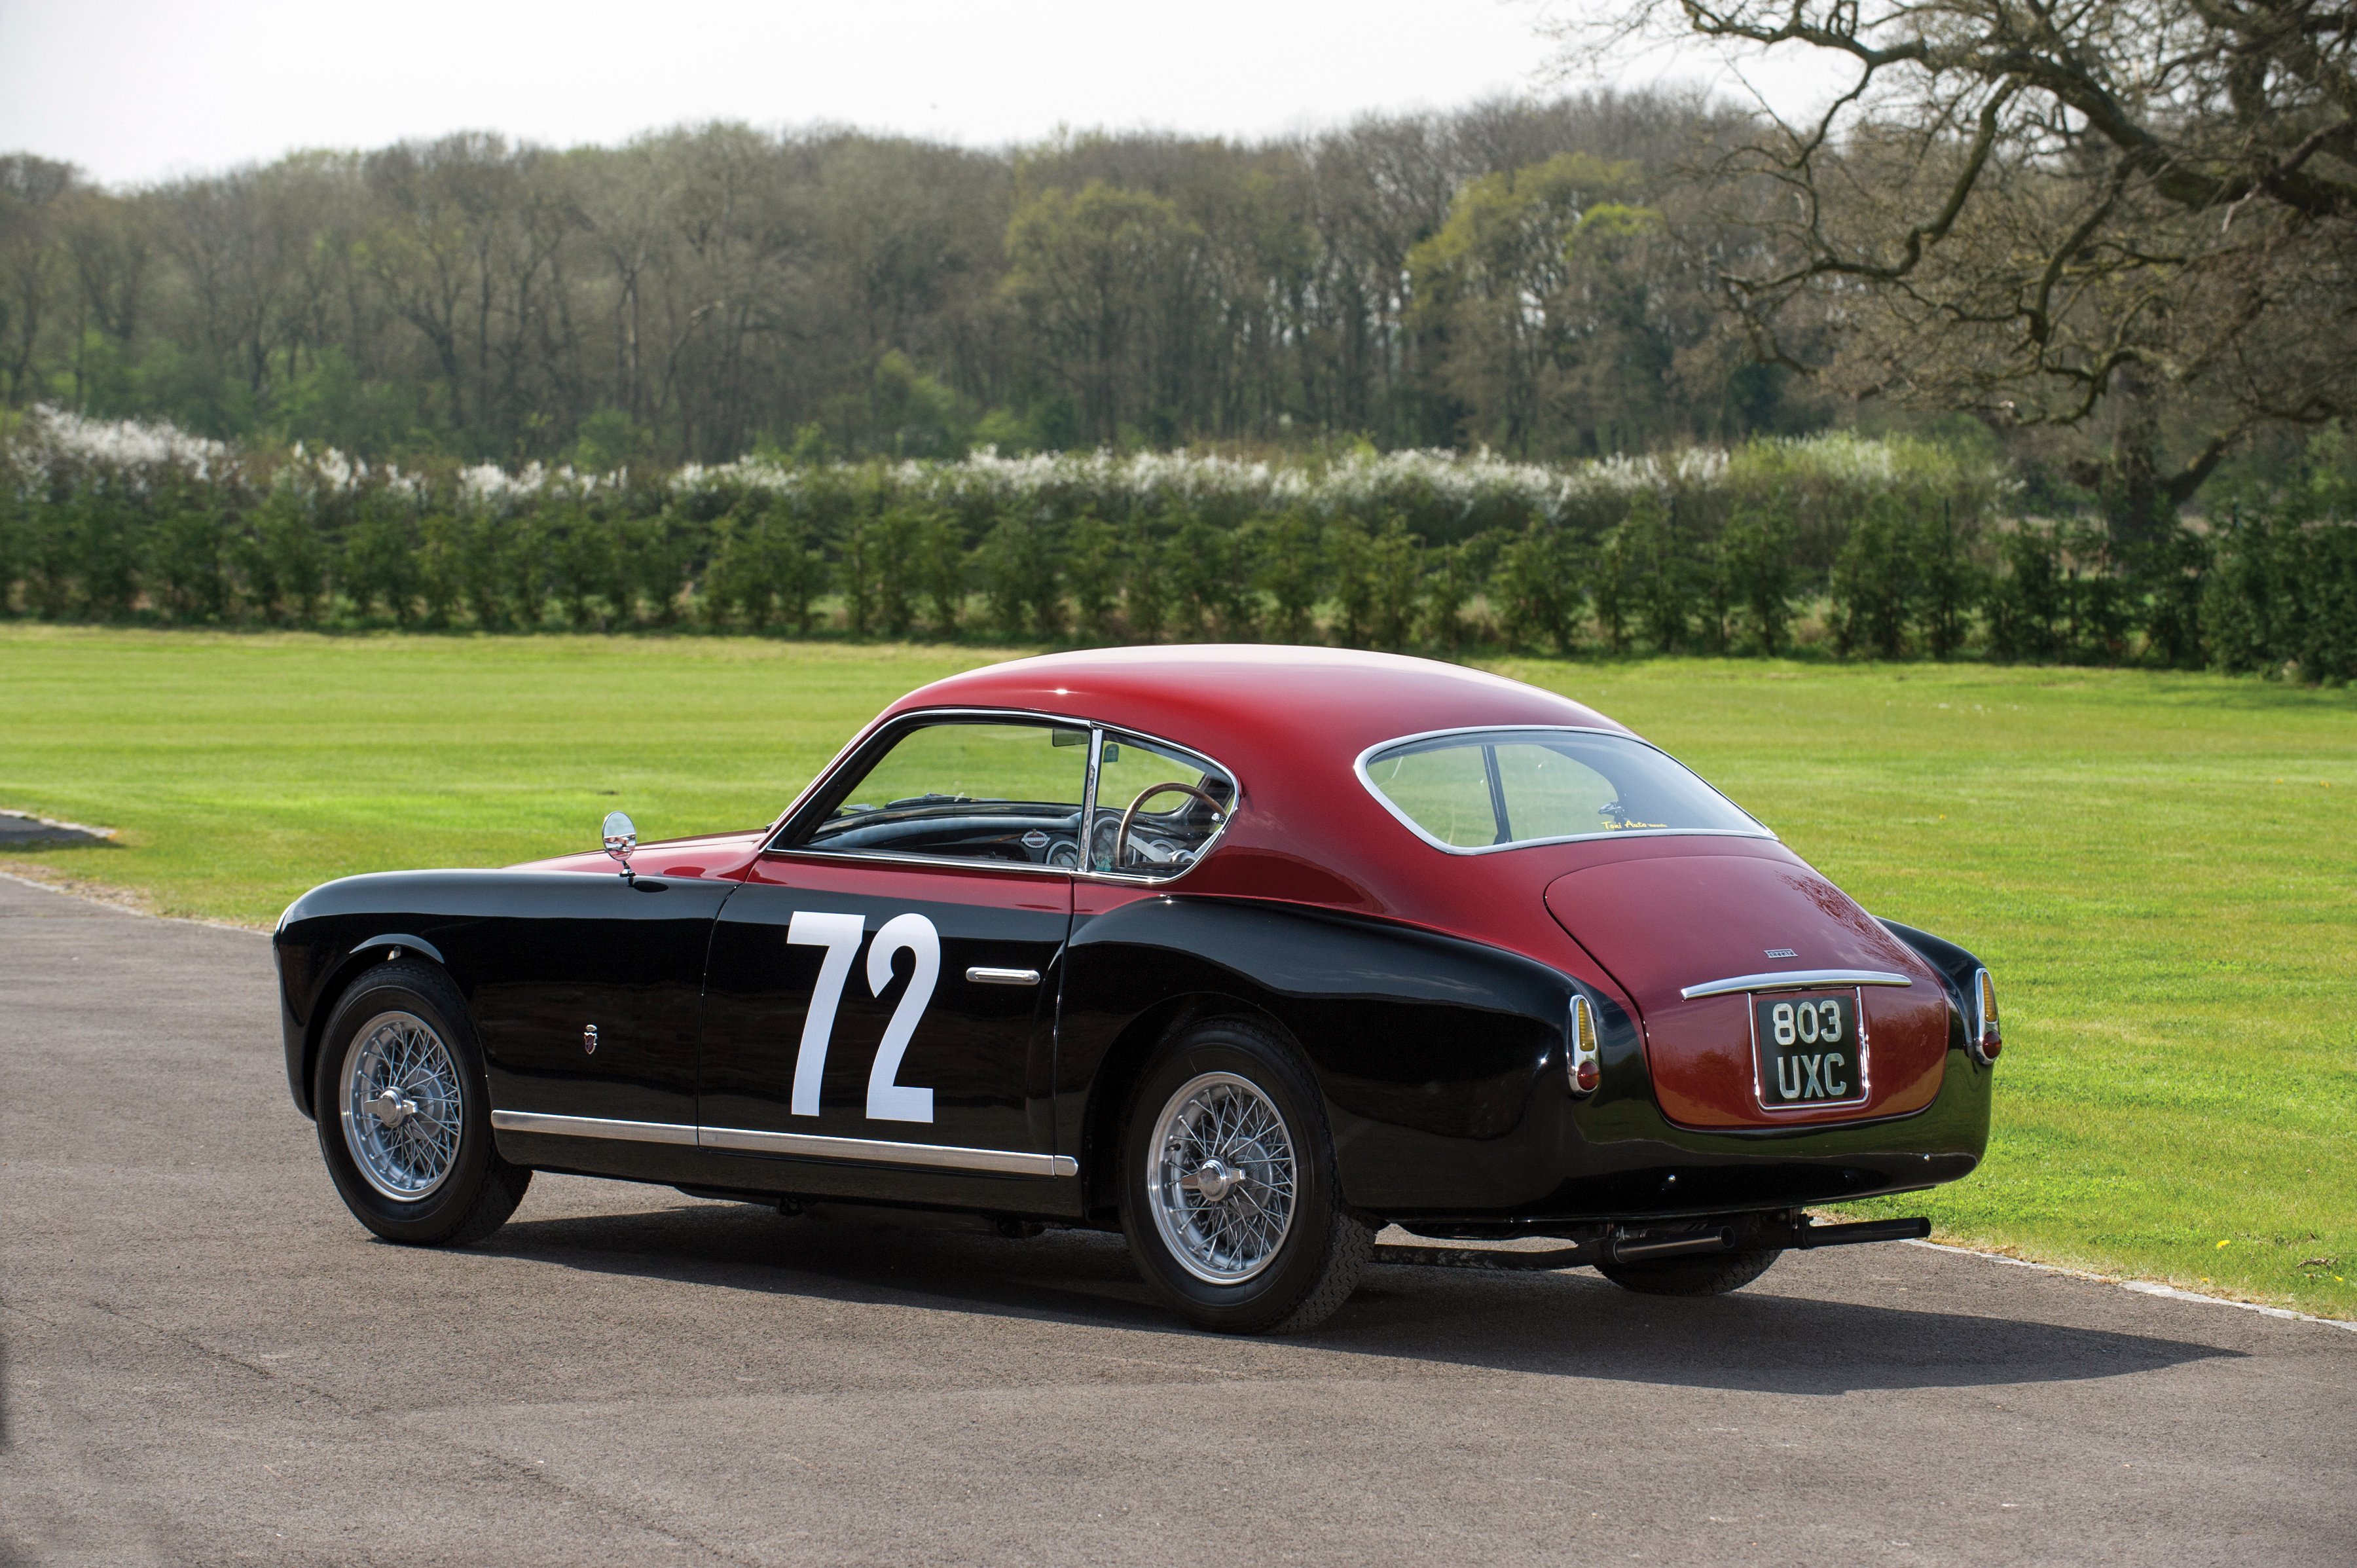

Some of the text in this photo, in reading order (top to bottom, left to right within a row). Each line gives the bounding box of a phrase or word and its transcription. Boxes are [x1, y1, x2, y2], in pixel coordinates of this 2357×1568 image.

[1624, 820, 1647, 828] Auto
[787, 911, 941, 1123] 72
[1772, 1000, 1842, 1046] 803
[1778, 1053, 1846, 1099] UXC
